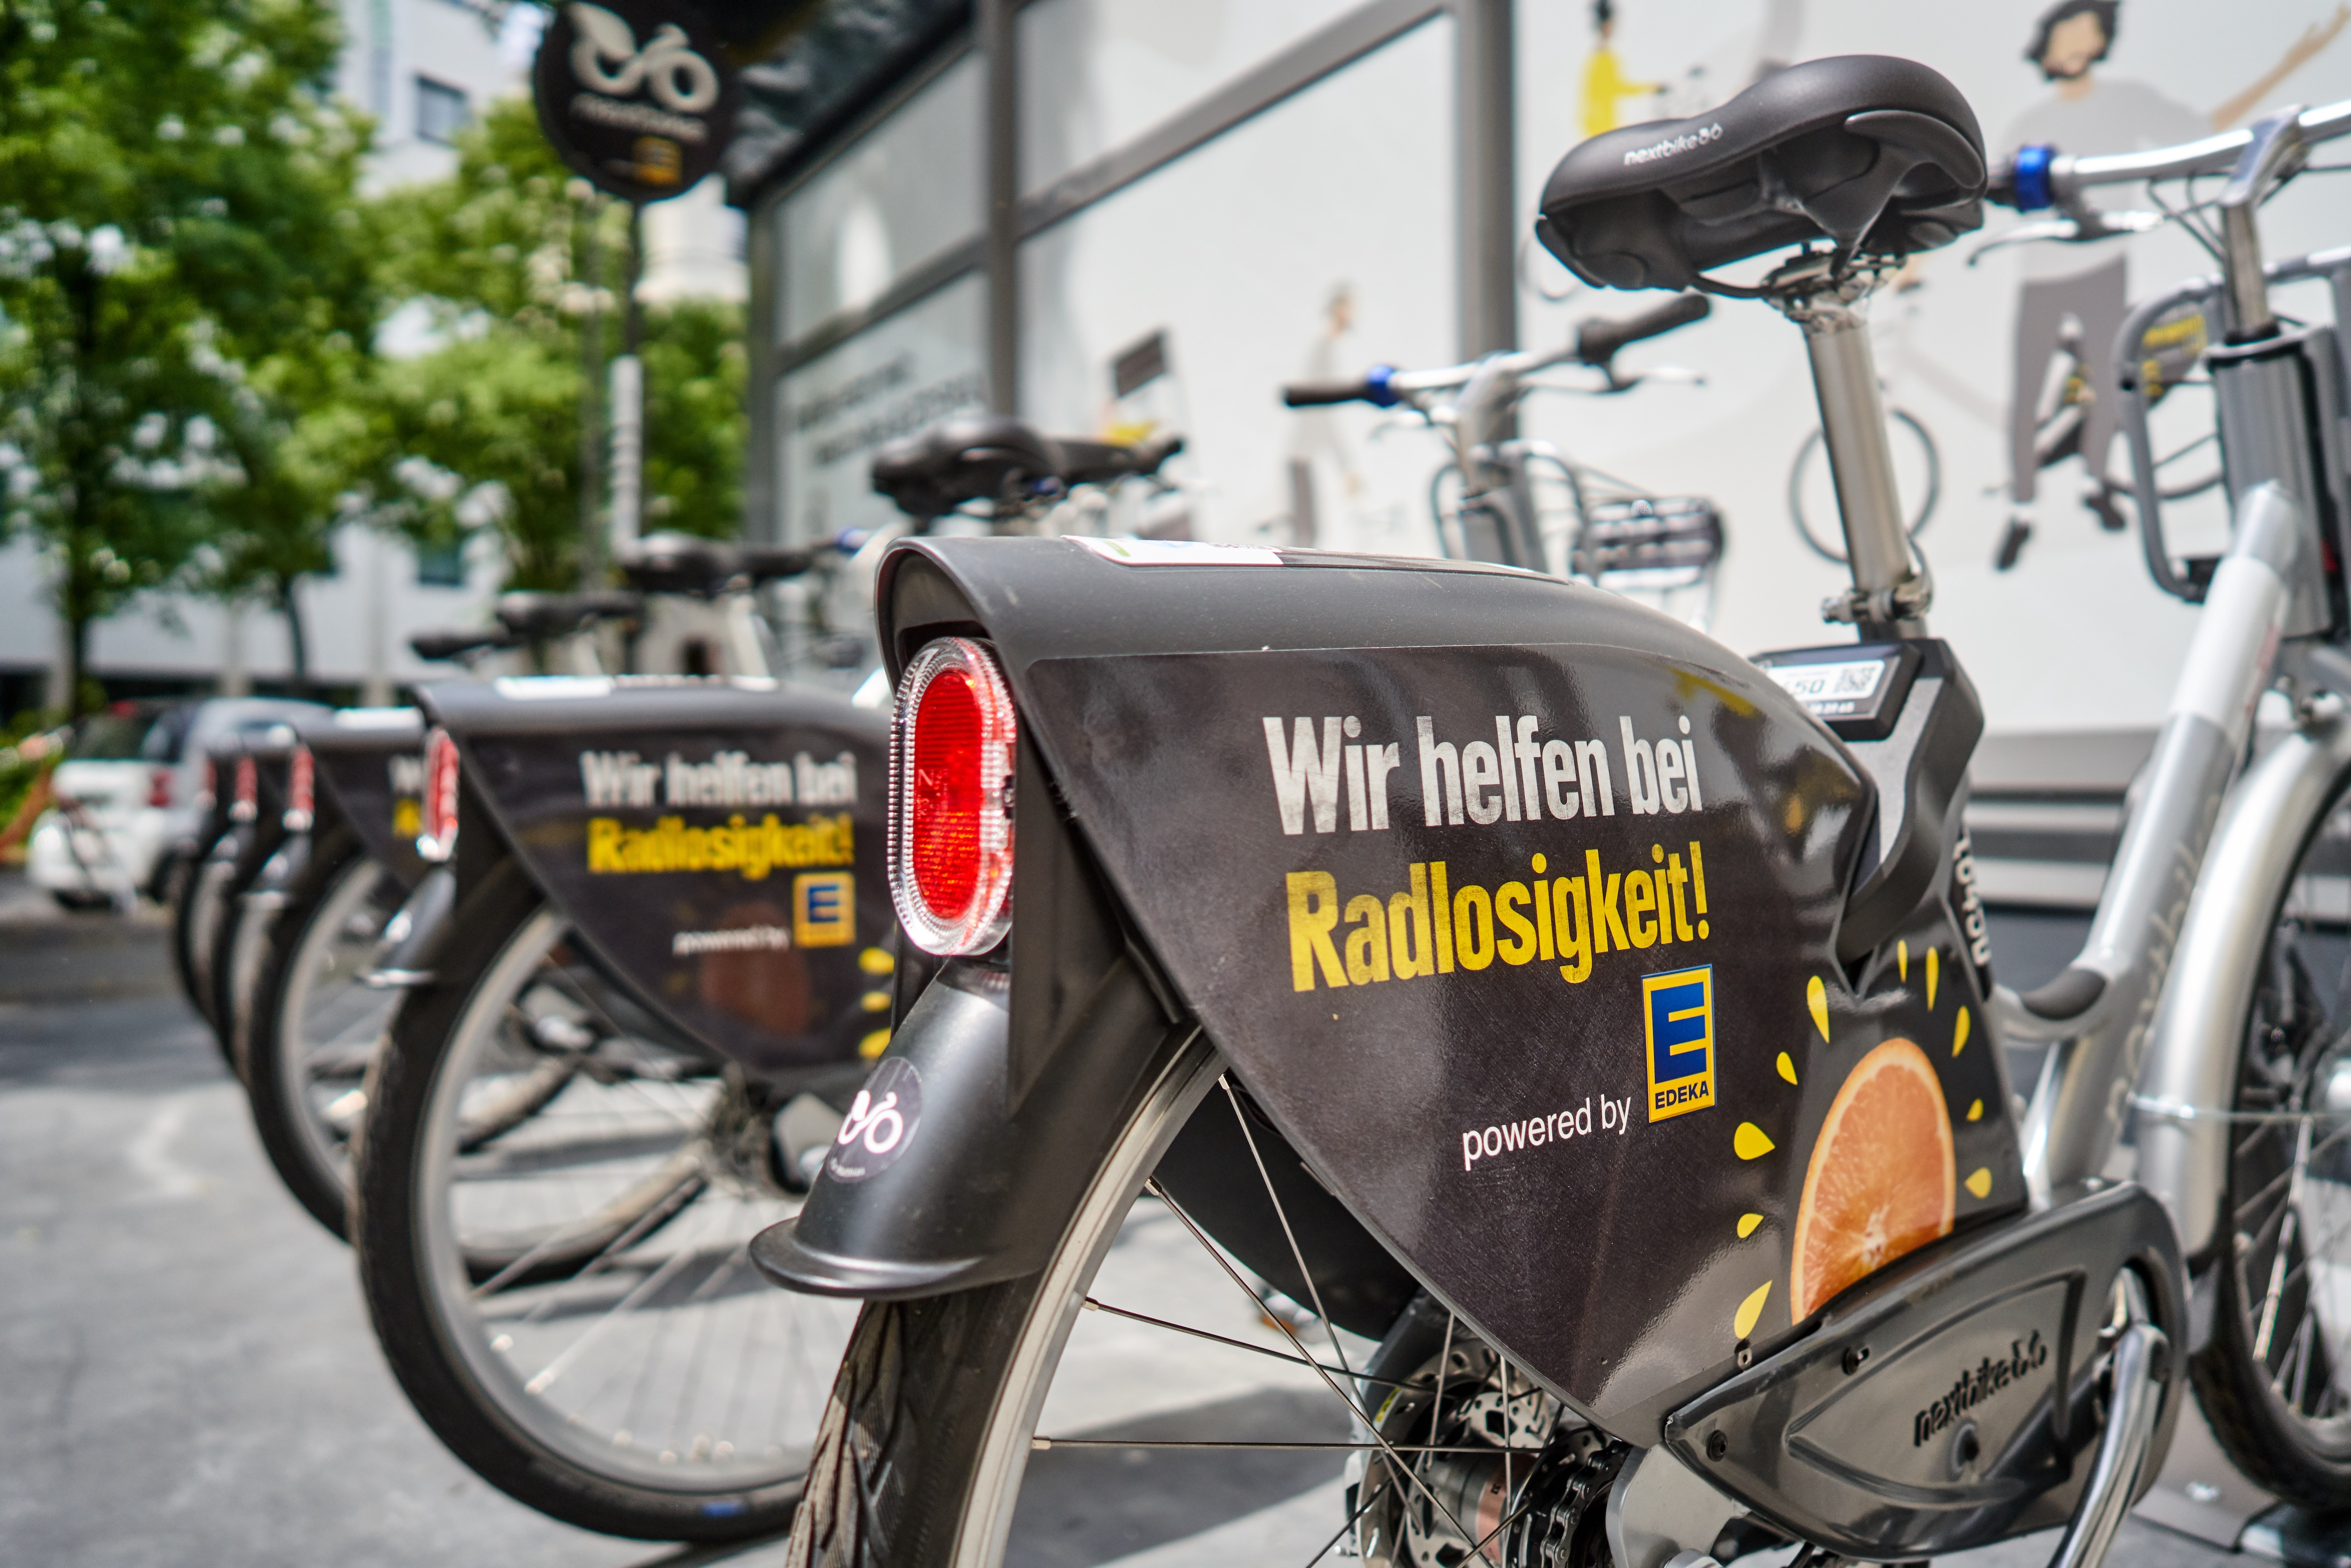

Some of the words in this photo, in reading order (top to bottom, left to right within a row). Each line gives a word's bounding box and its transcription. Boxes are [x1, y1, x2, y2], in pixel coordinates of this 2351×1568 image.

[580, 750, 661, 807] Wir
[1263, 716, 1400, 835] Wir
[1416, 716, 1615, 827] helfen
[1619, 716, 1703, 815] bei
[1286, 841, 1709, 992] Radlosigkeit!
[1462, 1098, 1592, 1170] powered
[1601, 1094, 1632, 1133] by
[1654, 1080, 1709, 1110] EDEKA
